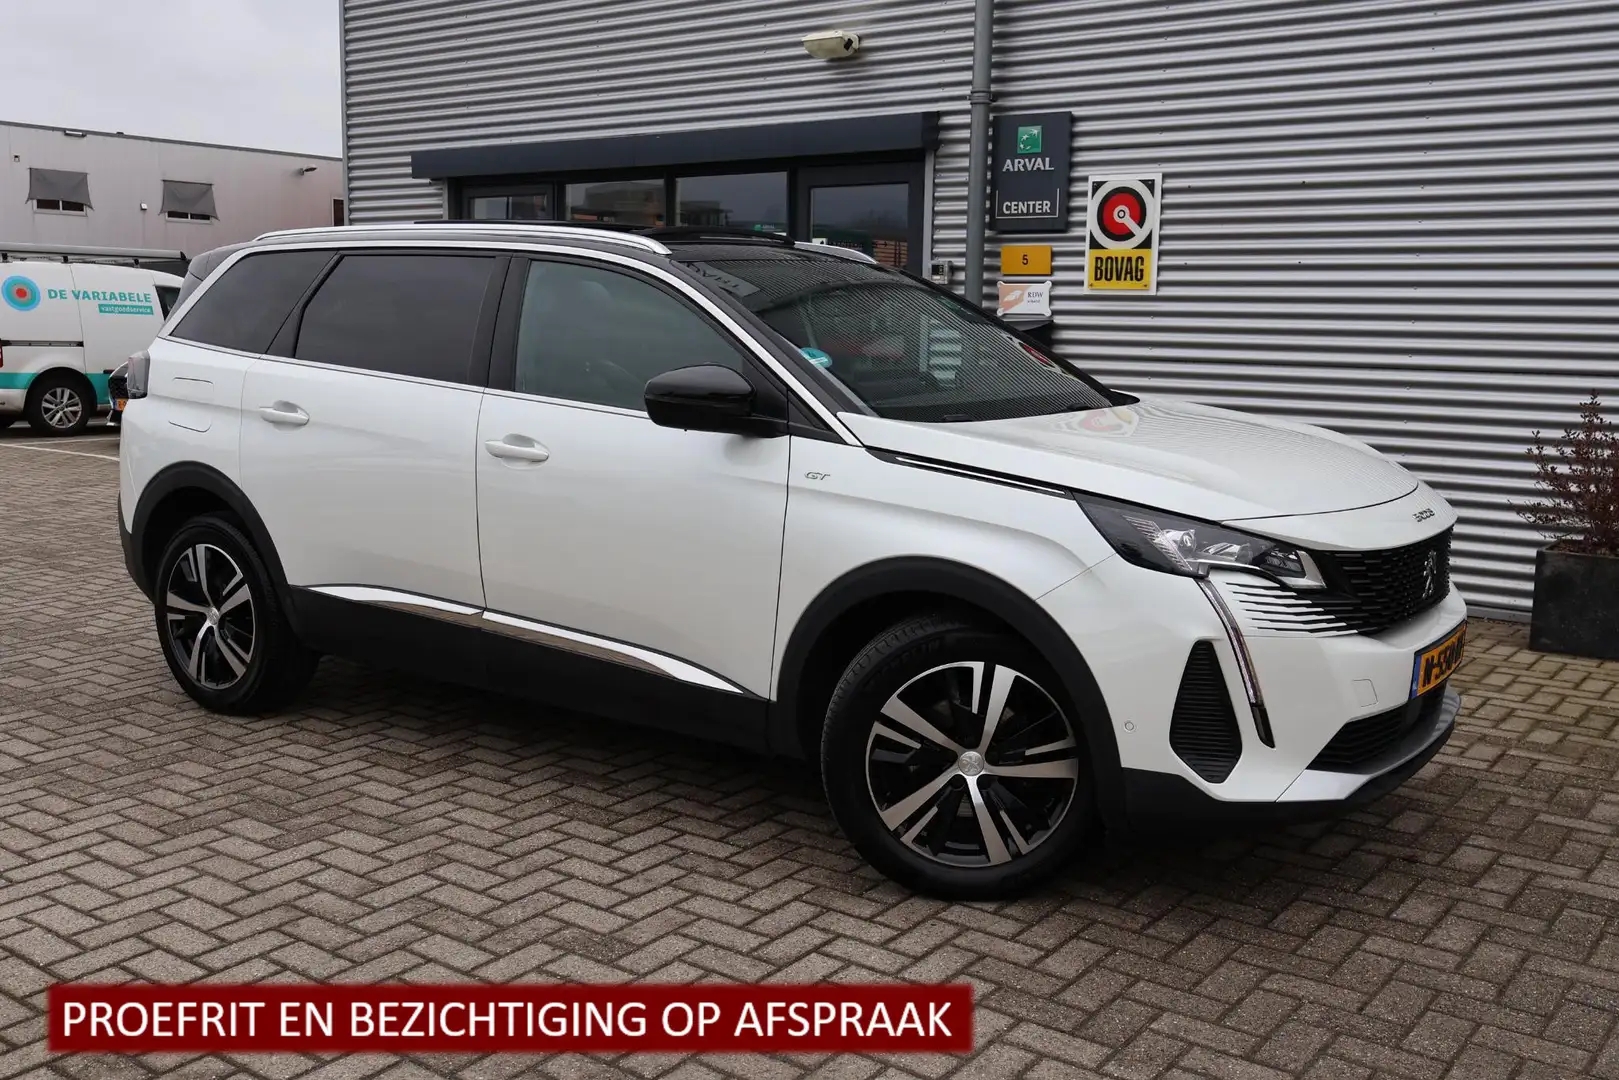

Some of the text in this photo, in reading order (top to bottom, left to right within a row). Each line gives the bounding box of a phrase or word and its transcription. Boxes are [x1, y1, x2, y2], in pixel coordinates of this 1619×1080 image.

[1002, 157, 1054, 172] ARVAL
[1002, 200, 1051, 214] CENTER
[1021, 254, 1029, 266] 5
[1094, 256, 1145, 282] BOVAG
[47, 288, 153, 303] DE VARIABELE
[804, 471, 831, 481] GT
